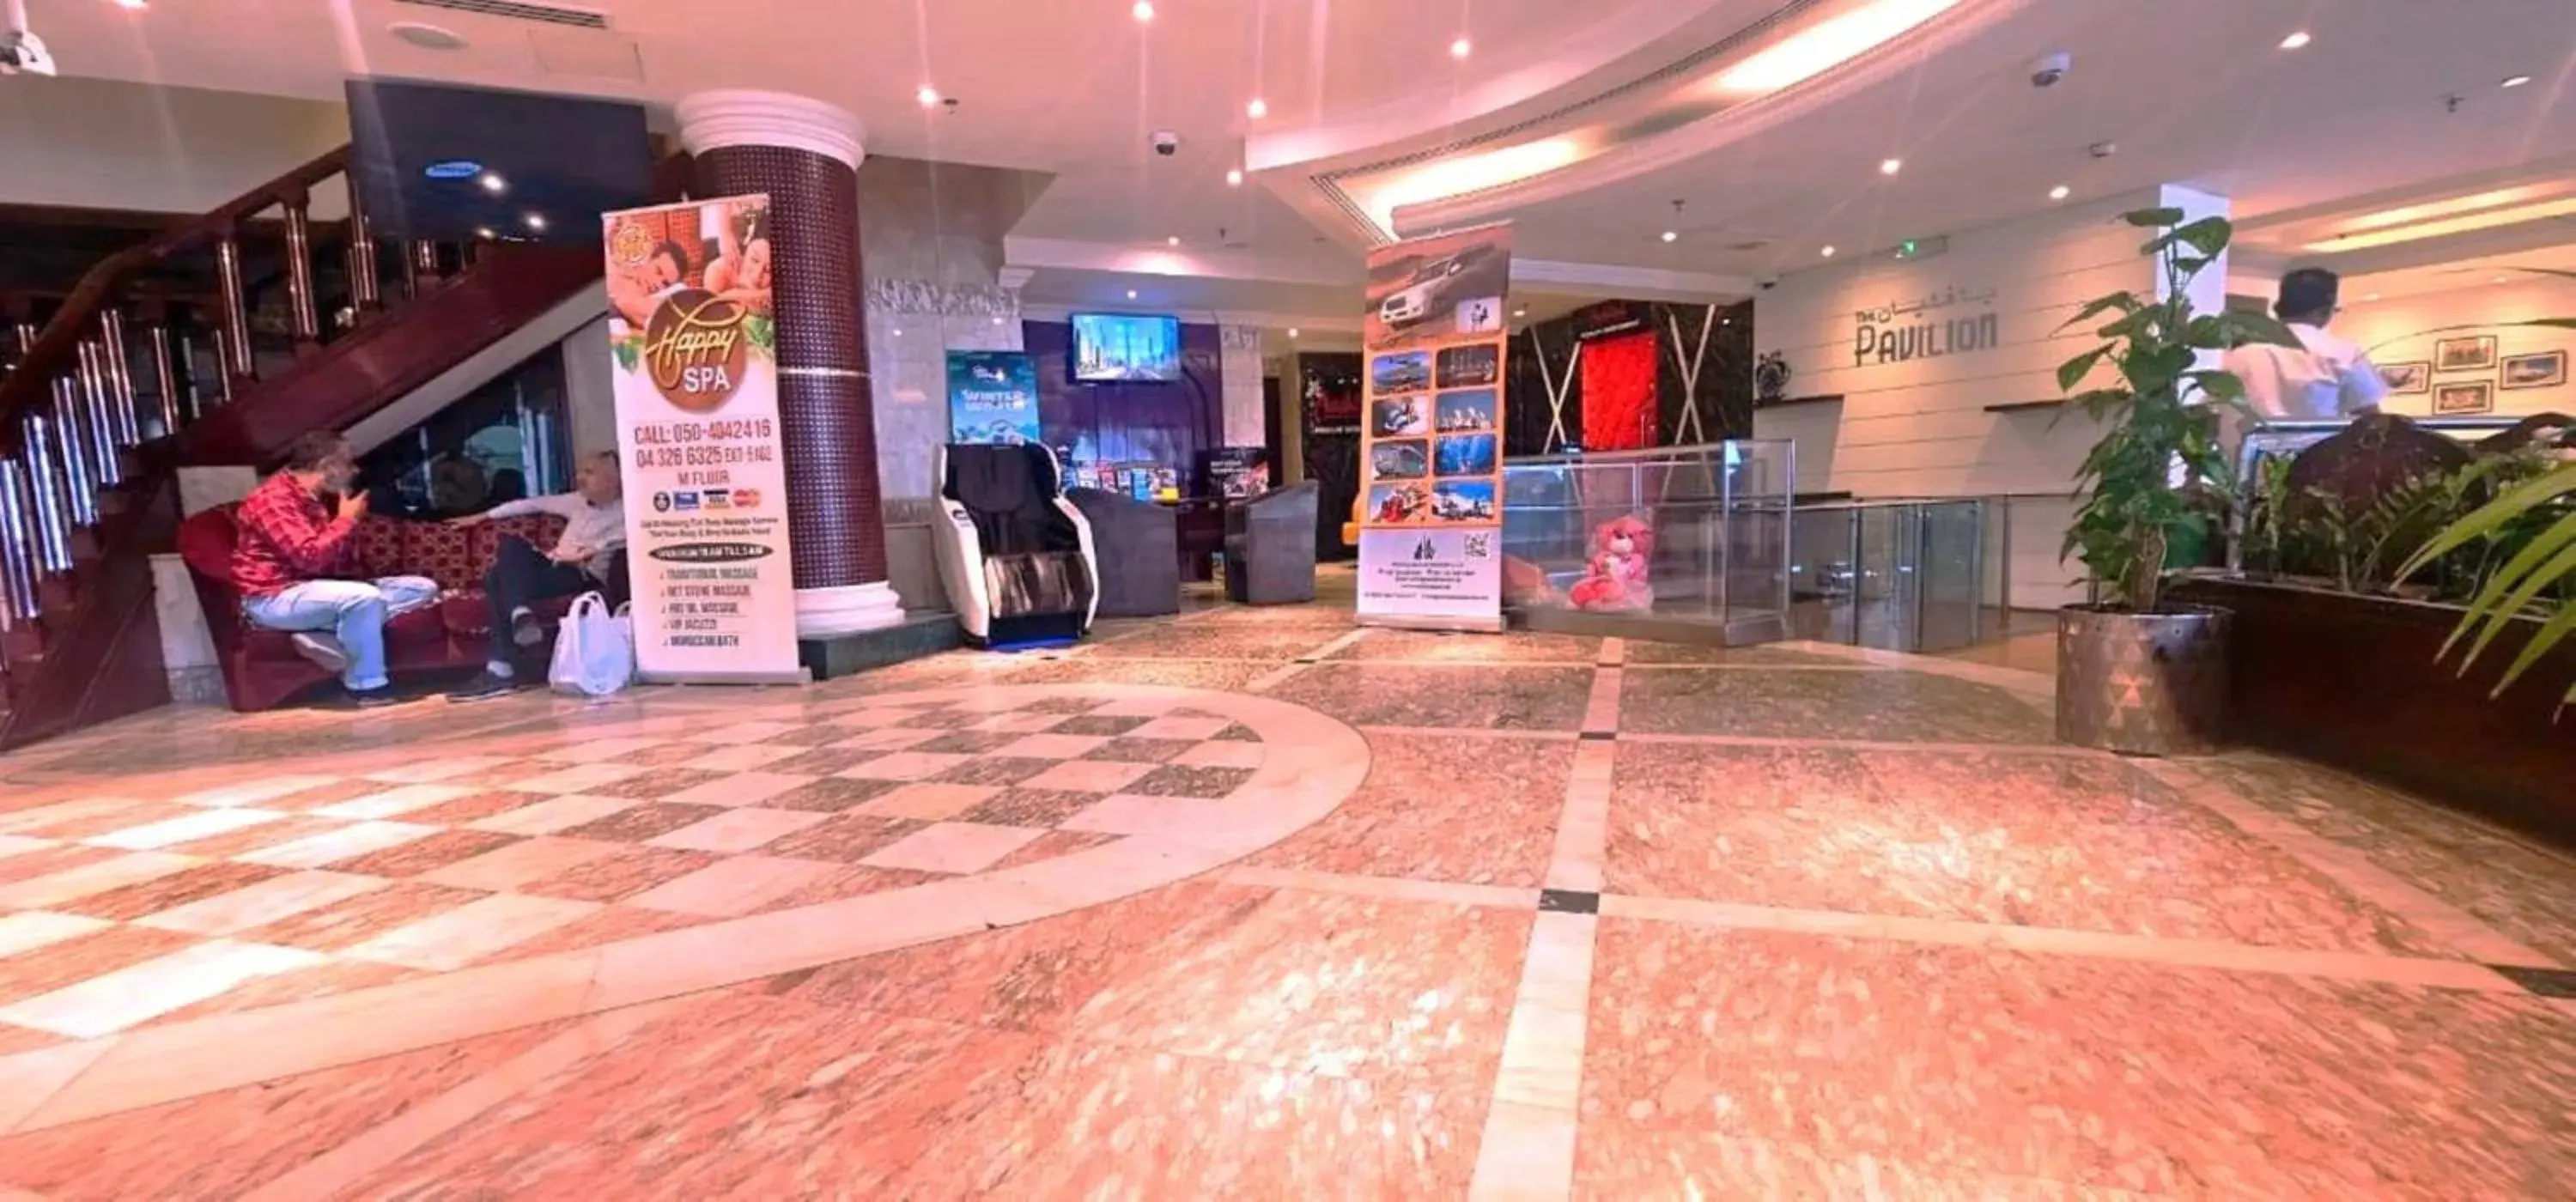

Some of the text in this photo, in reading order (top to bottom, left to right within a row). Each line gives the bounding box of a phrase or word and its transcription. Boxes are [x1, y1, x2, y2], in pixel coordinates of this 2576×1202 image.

[645, 293, 747, 389] Happy
[1855, 313, 1998, 367] PAVILION
[683, 366, 730, 392] SPA
[635, 425, 671, 445] CALL:
[636, 449, 653, 468] 04
[659, 446, 683, 467] 326
[687, 446, 722, 466] 6325
